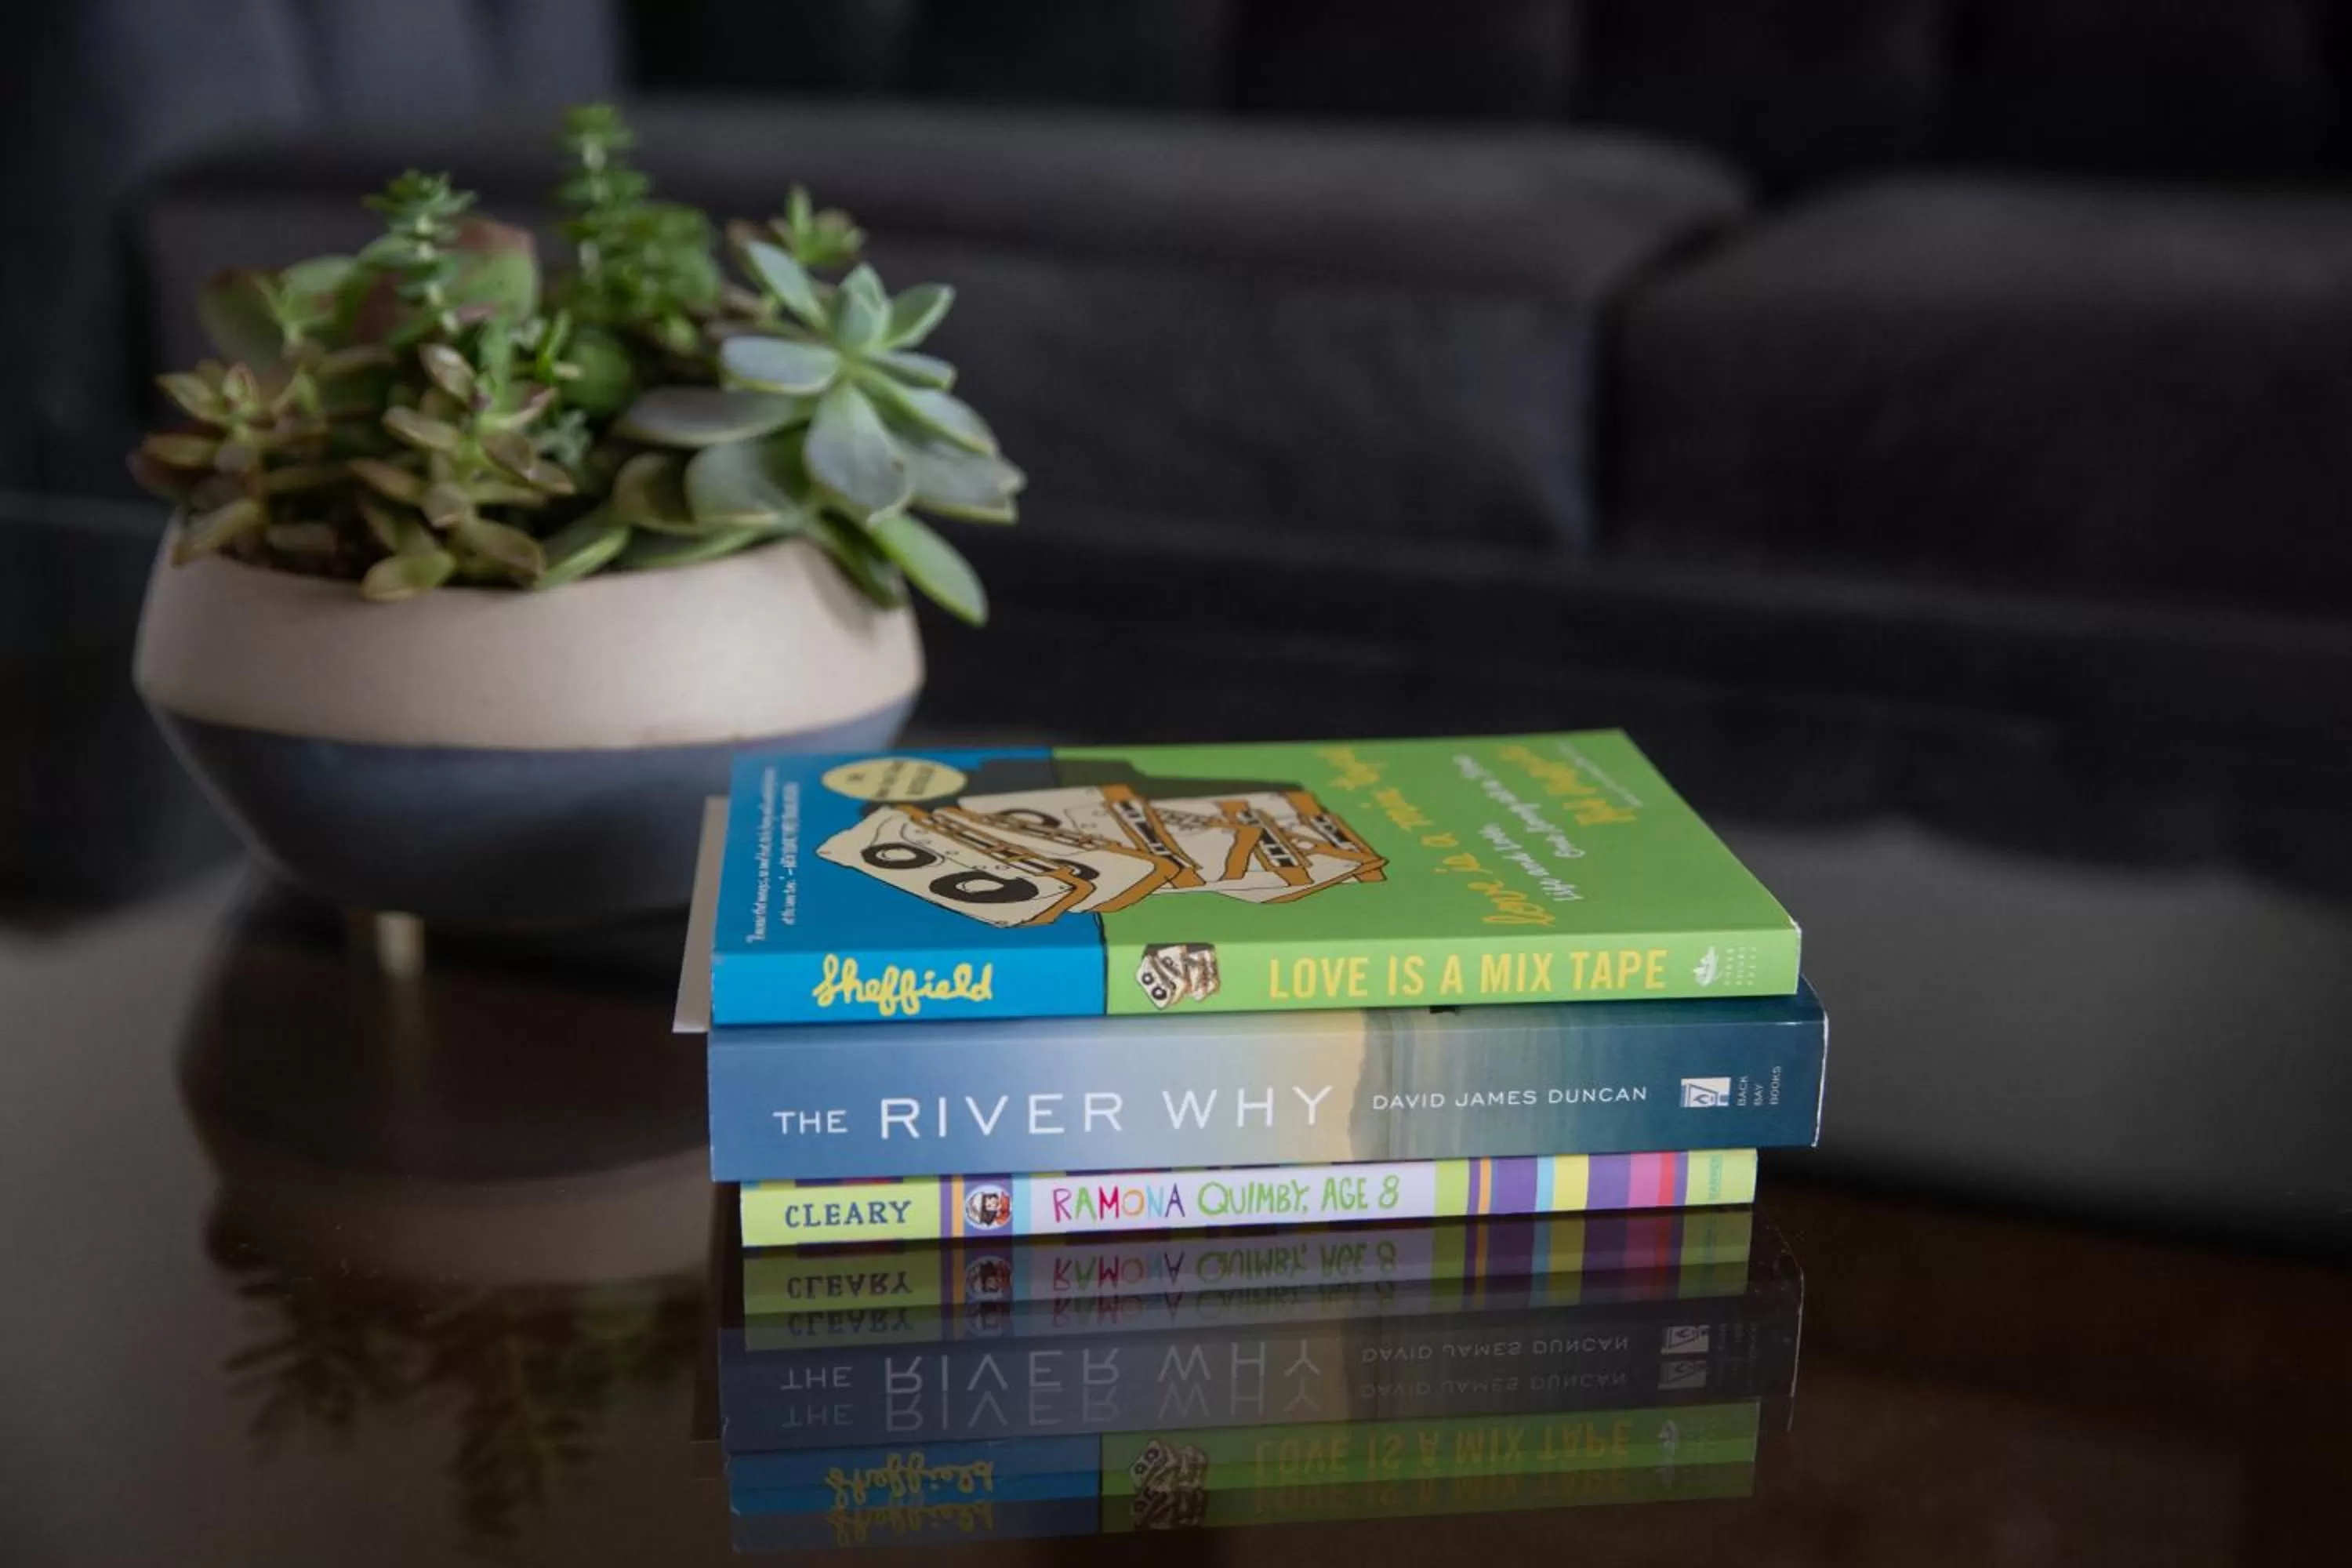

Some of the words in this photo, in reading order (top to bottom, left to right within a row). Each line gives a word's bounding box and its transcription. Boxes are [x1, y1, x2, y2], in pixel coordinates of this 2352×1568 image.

[1421, 833, 1458, 848] a
[1468, 879, 1555, 926] love
[812, 953, 993, 1016] Sheffield
[1269, 956, 1368, 999] LOVE
[1388, 955, 1425, 996] IS
[1439, 954, 1464, 993] A
[1480, 953, 1553, 993] MIX
[1570, 949, 1668, 991] TAPE
[1373, 1093, 1445, 1110] DAVID
[1455, 1090, 1537, 1107] JAMES
[1548, 1087, 1647, 1105] DUNCAN
[1769, 1065, 1782, 1105] BOOKS
[773, 1109, 848, 1134] THE
[880, 1093, 1123, 1139] RIVER
[1162, 1085, 1332, 1130] WHY
[785, 1201, 912, 1228] CLEARY
[1053, 1182, 1186, 1223] RAMONA
[1198, 1178, 1311, 1215] QUIMBY,
[1320, 1176, 1368, 1211] AGE
[1378, 1174, 1400, 1209] 8
